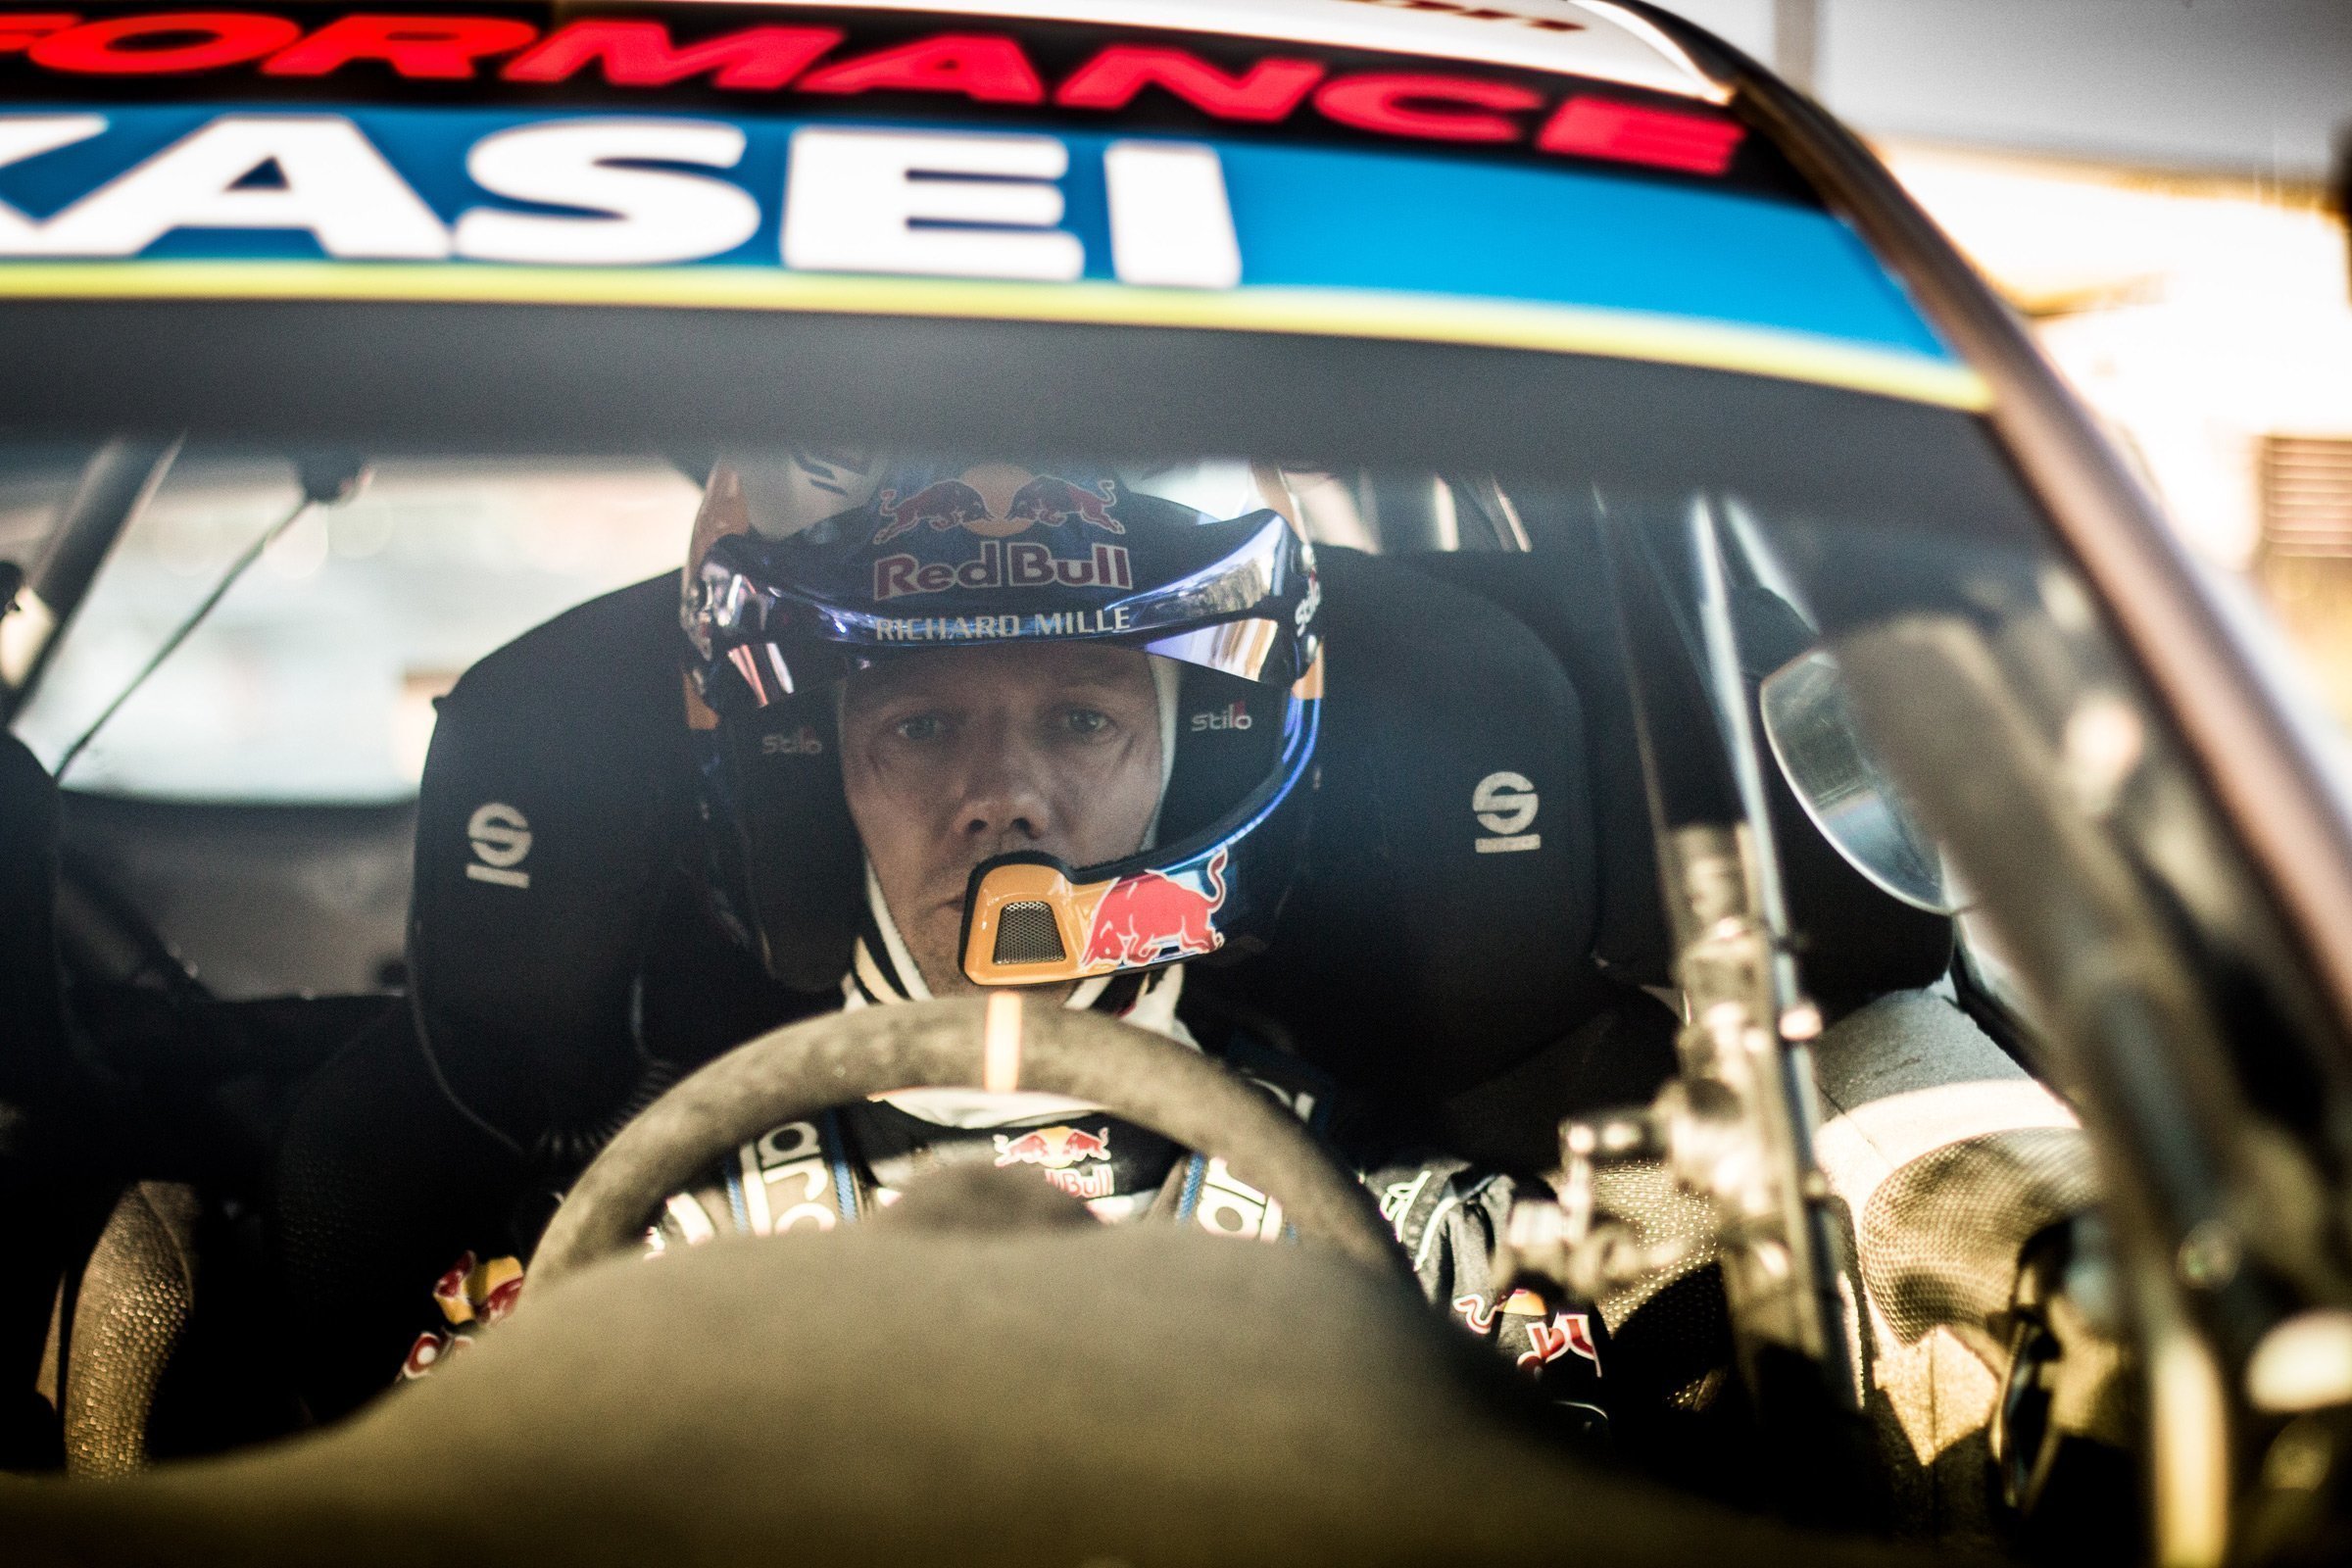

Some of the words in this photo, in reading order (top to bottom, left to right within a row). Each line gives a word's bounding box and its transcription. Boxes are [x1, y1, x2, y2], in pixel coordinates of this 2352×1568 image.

[874, 551, 1002, 601] Red
[1007, 542, 1133, 590] Bull
[876, 616, 1019, 641] RICHARD
[1034, 607, 1131, 636] MILLE
